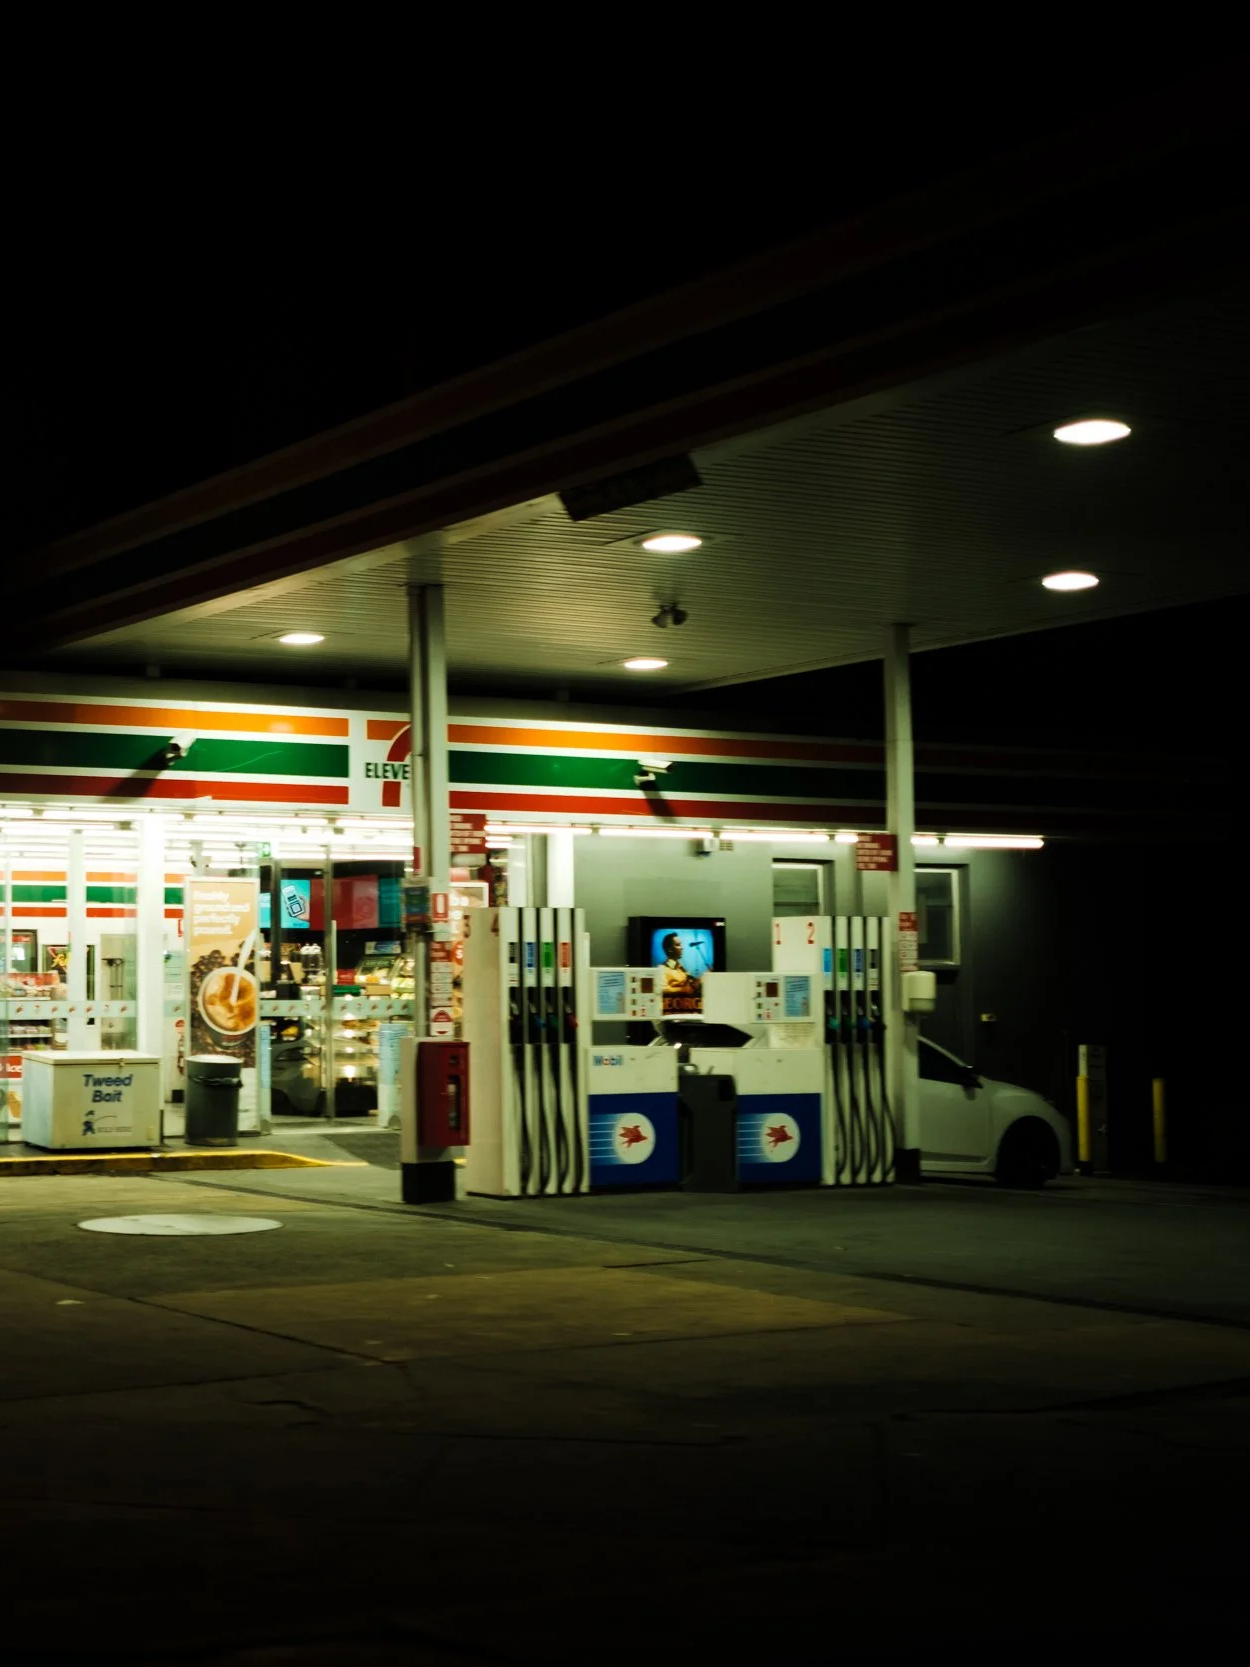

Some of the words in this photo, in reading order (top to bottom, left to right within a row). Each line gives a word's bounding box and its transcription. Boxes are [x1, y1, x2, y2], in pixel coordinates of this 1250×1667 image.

[365, 762, 410, 779] ELEVE
[774, 922, 781, 945] 1
[806, 921, 815, 945] 2
[663, 997, 702, 1010] EORG
[592, 1054, 624, 1066] Mobil
[82, 1073, 134, 1087] Tweed
[92, 1089, 123, 1103] Bait
